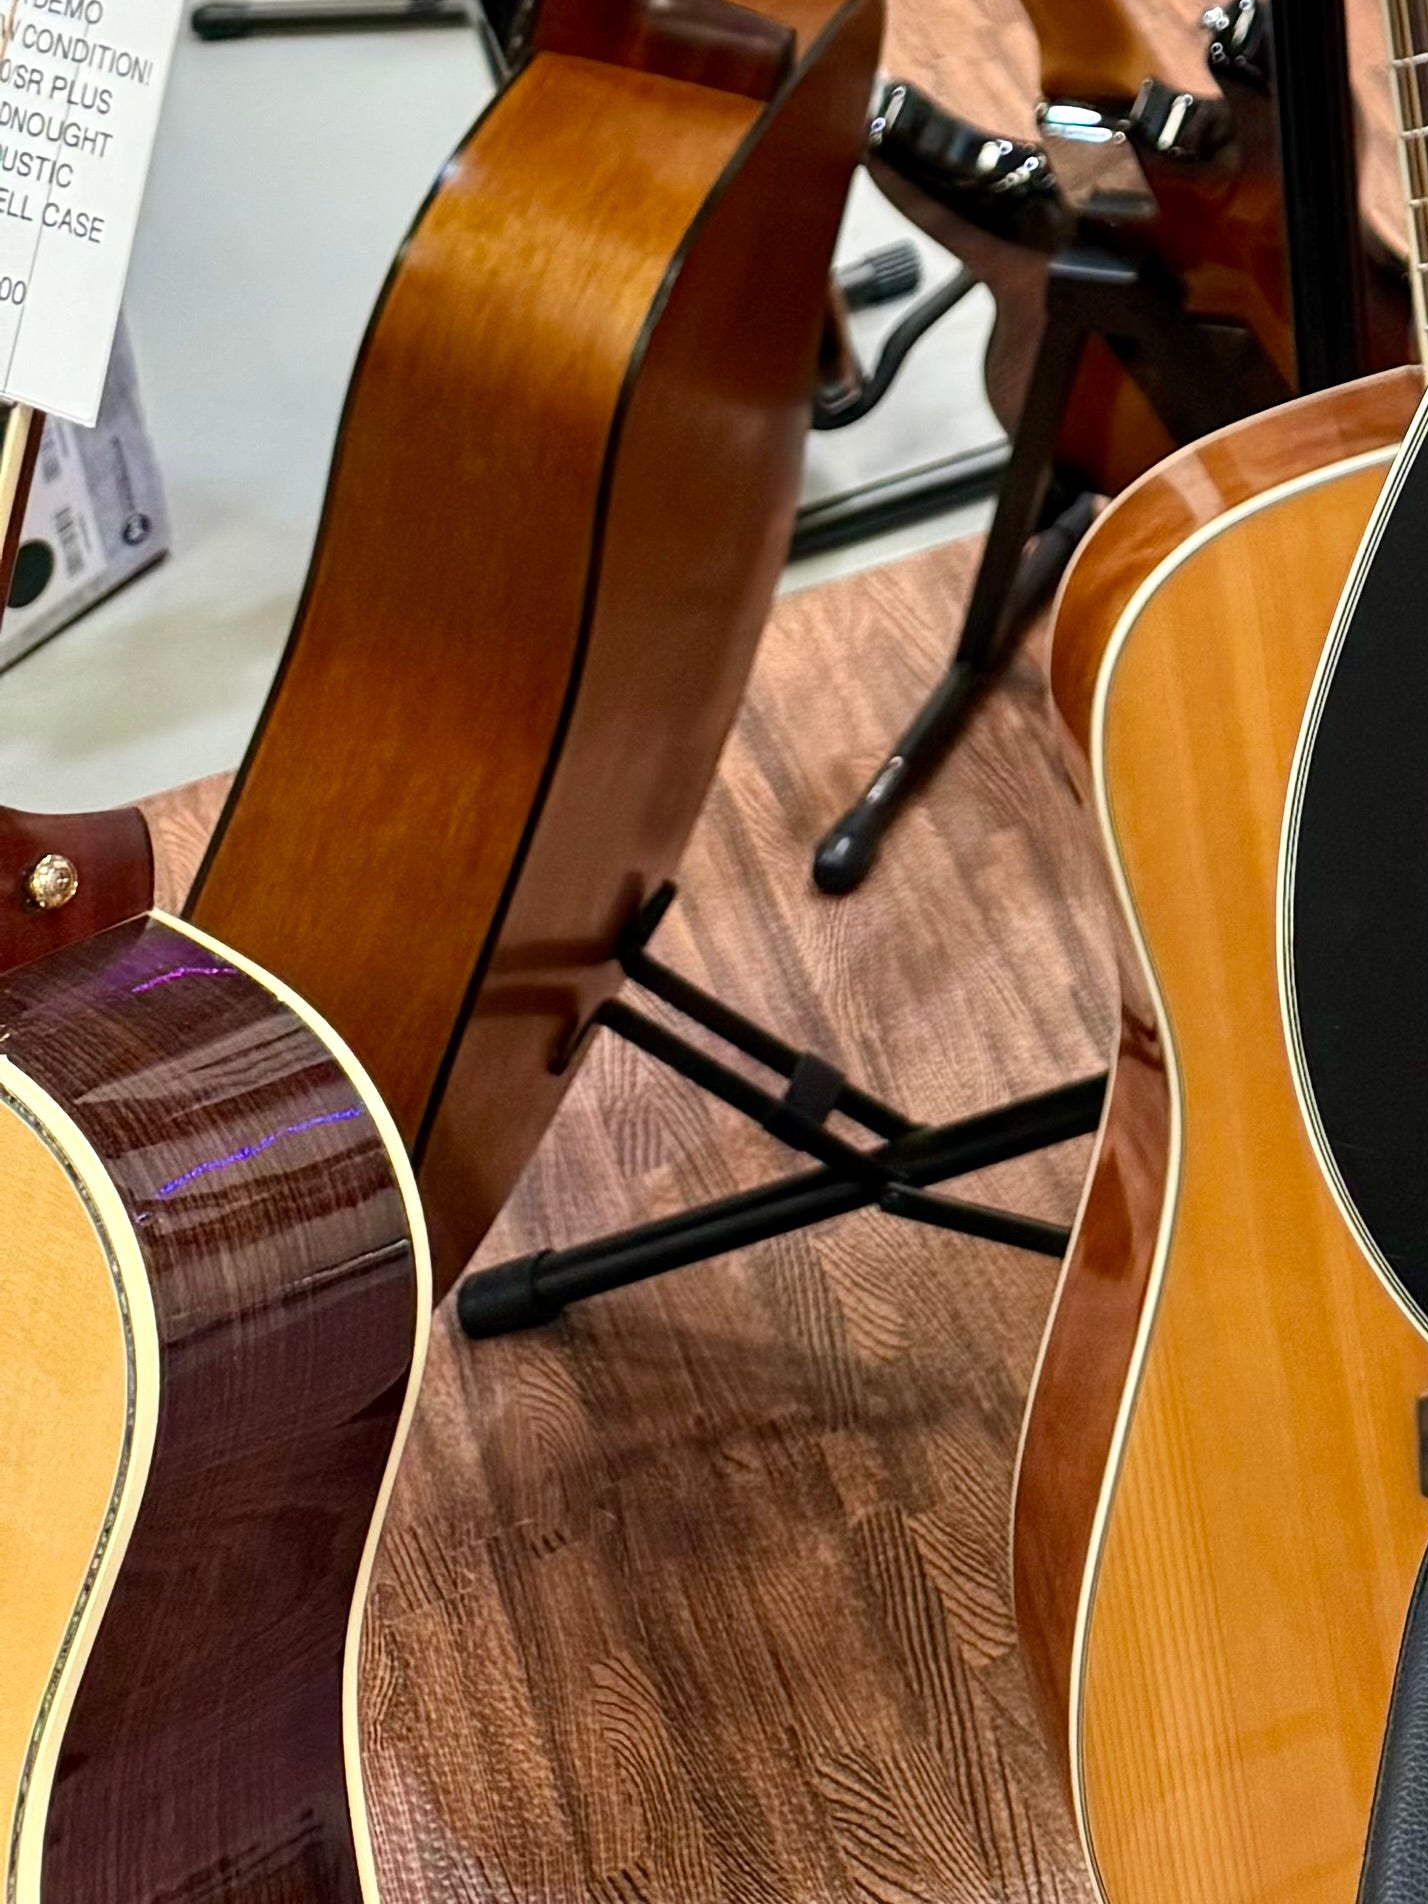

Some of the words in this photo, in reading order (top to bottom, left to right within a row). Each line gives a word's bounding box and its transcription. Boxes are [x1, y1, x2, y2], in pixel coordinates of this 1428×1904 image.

[22, 23, 155, 86] CONDITION!
[48, 74, 114, 116] PLUS
[0, 100, 114, 159] DNOUGHT
[0, 145, 74, 189] USTIC
[0, 186, 34, 223] ELL
[41, 201, 105, 245] CASE
[0, 275, 28, 307] 00
